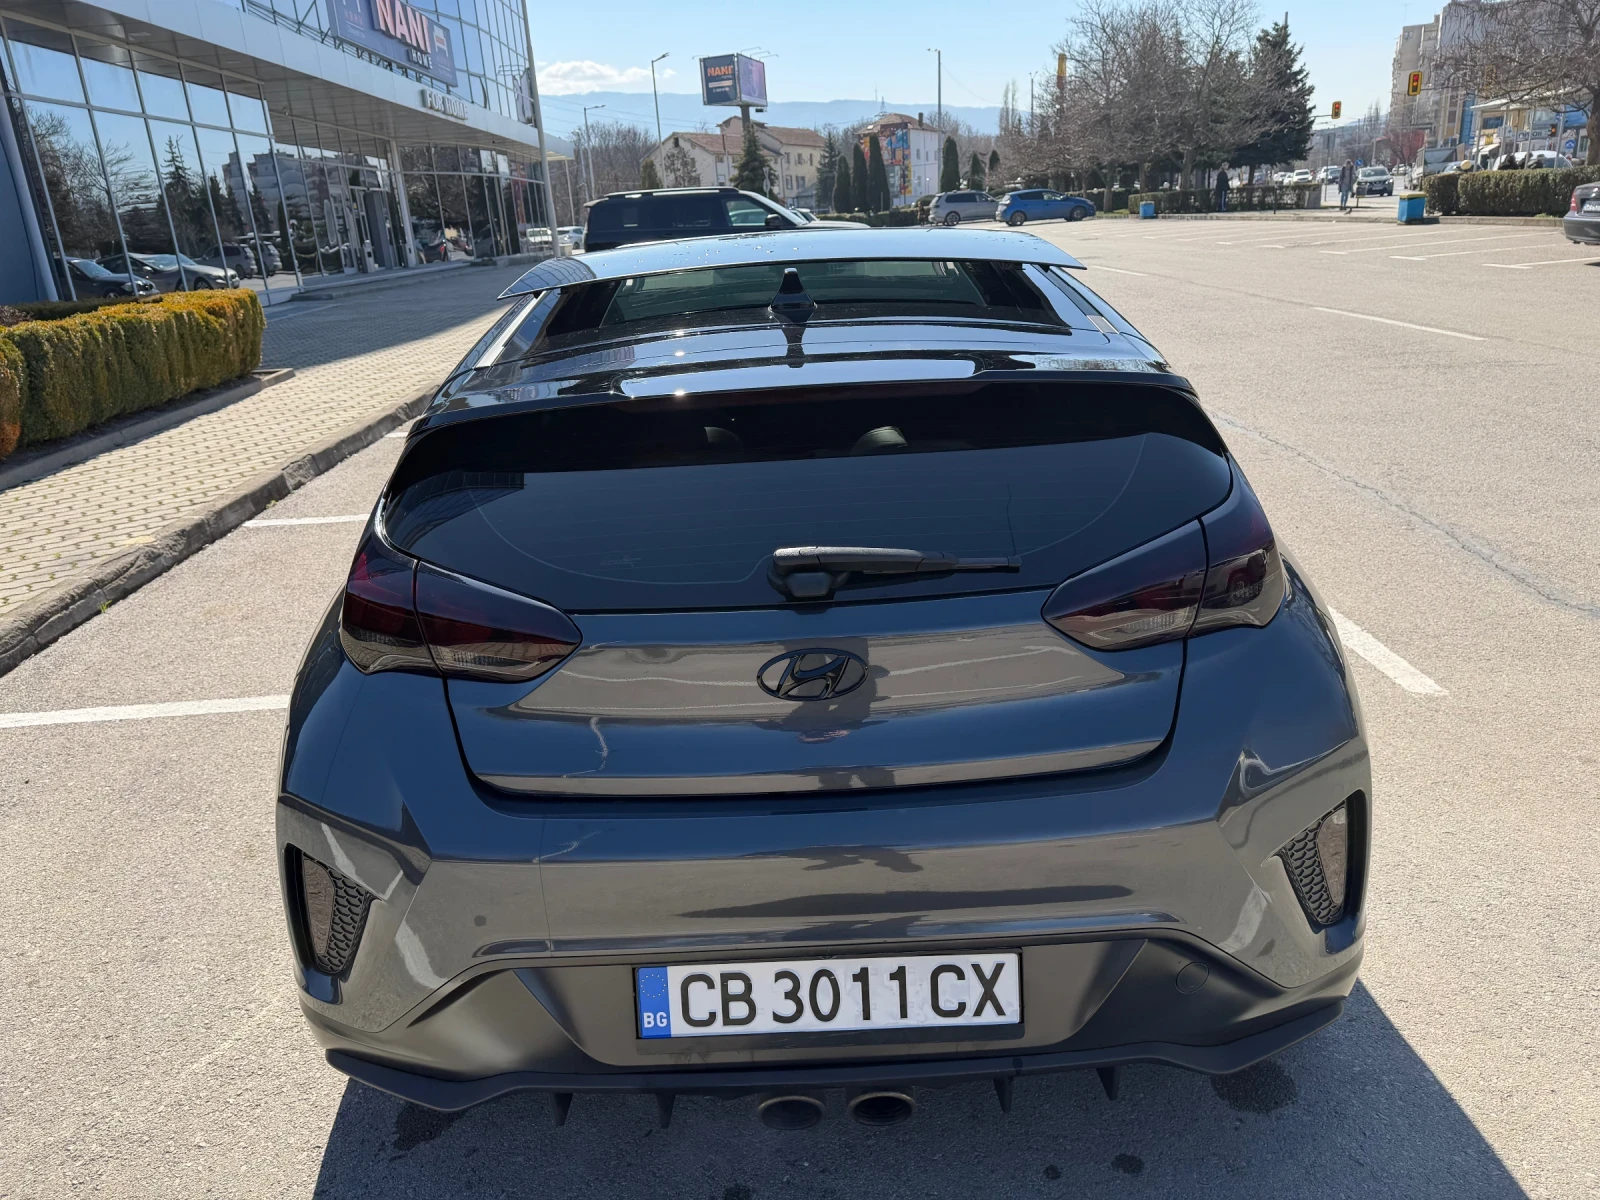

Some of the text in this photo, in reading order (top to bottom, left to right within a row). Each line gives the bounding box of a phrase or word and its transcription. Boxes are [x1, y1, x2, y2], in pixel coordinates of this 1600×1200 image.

[376, 0, 431, 54] NANI
[411, 48, 433, 69] HOME
[707, 65, 732, 77] NANI
[426, 90, 468, 119] FOR HOME
[680, 962, 1006, 1028] CB 3011 CX
[643, 1011, 668, 1028] BG
